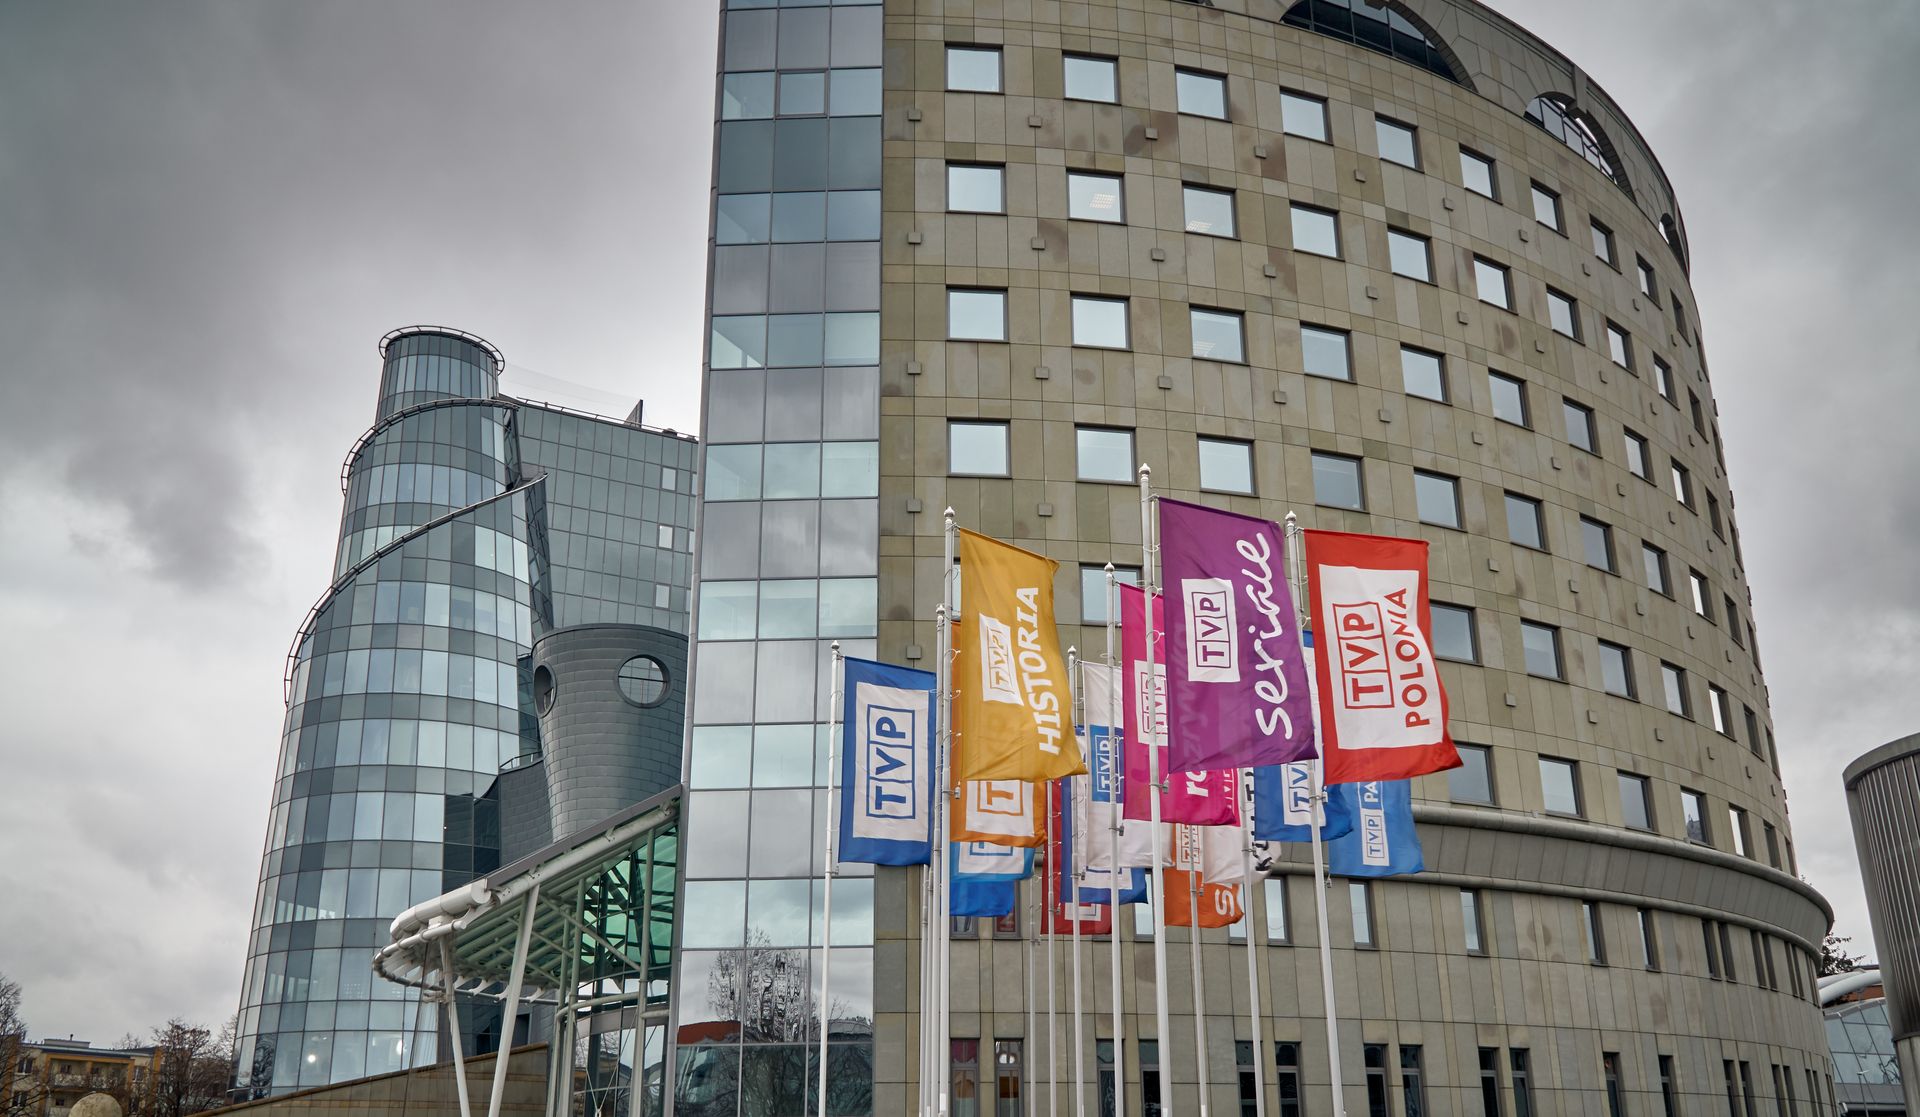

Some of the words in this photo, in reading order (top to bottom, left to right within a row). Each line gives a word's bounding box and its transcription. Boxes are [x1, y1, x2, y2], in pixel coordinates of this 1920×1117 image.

[991, 632, 1012, 689] TVP
[1016, 587, 1061, 756] HISTORIA
[1199, 596, 1225, 663] TVP
[1342, 612, 1384, 703] TVP
[1384, 588, 1430, 728] POLONIA
[874, 715, 908, 811] TVP
[1366, 817, 1382, 856] TVP
